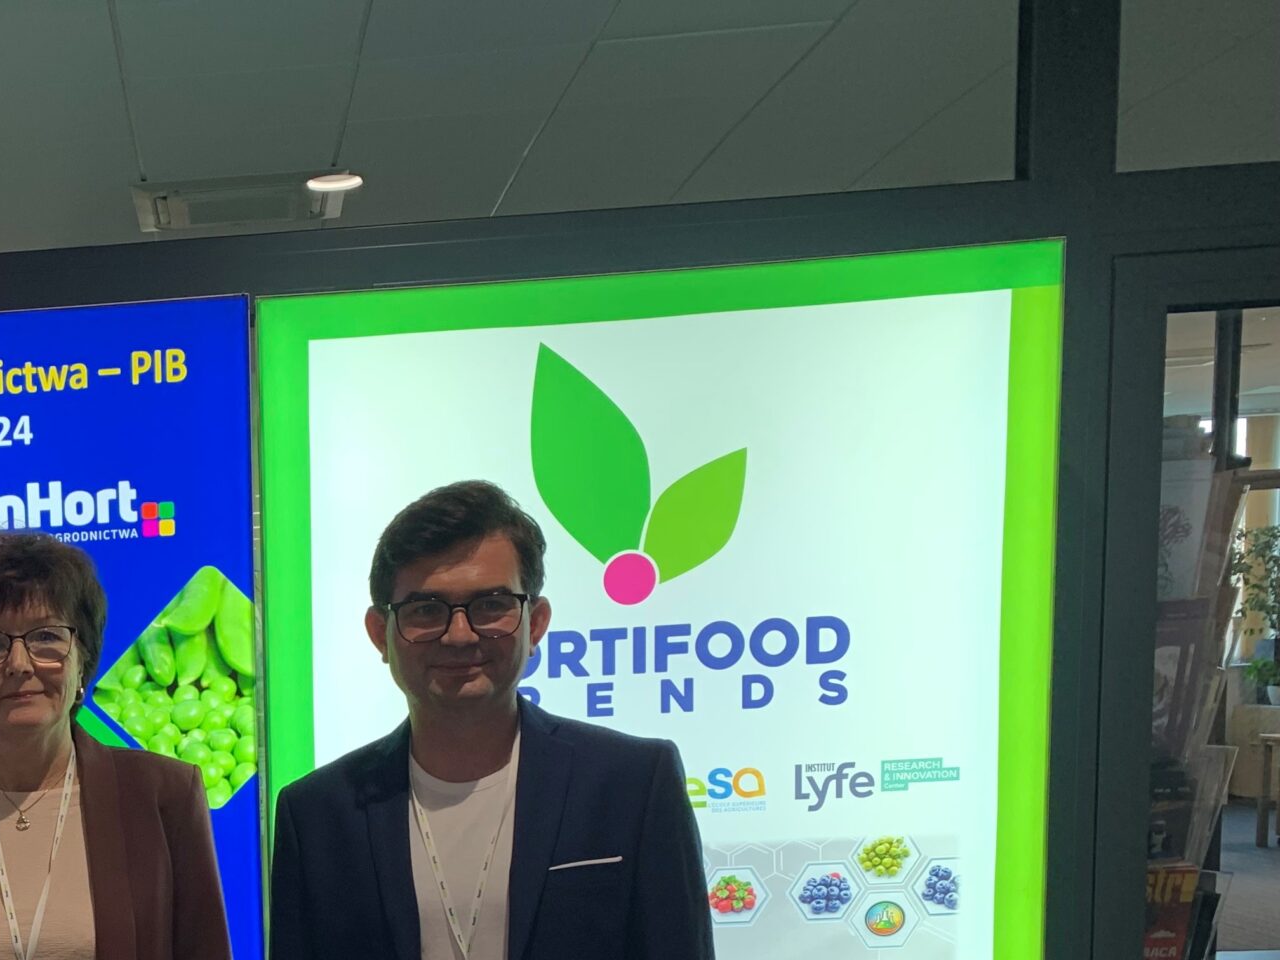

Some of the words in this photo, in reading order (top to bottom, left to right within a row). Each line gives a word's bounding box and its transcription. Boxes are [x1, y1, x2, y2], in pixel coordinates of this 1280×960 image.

[131, 349, 188, 385] PIB
[521, 616, 851, 680] RTIFOOD
[805, 763, 835, 772] INSTITUT
[884, 760, 941, 771] RESEARCH
[893, 769, 957, 781] INNOVATION
[795, 762, 875, 812] Lyfe
